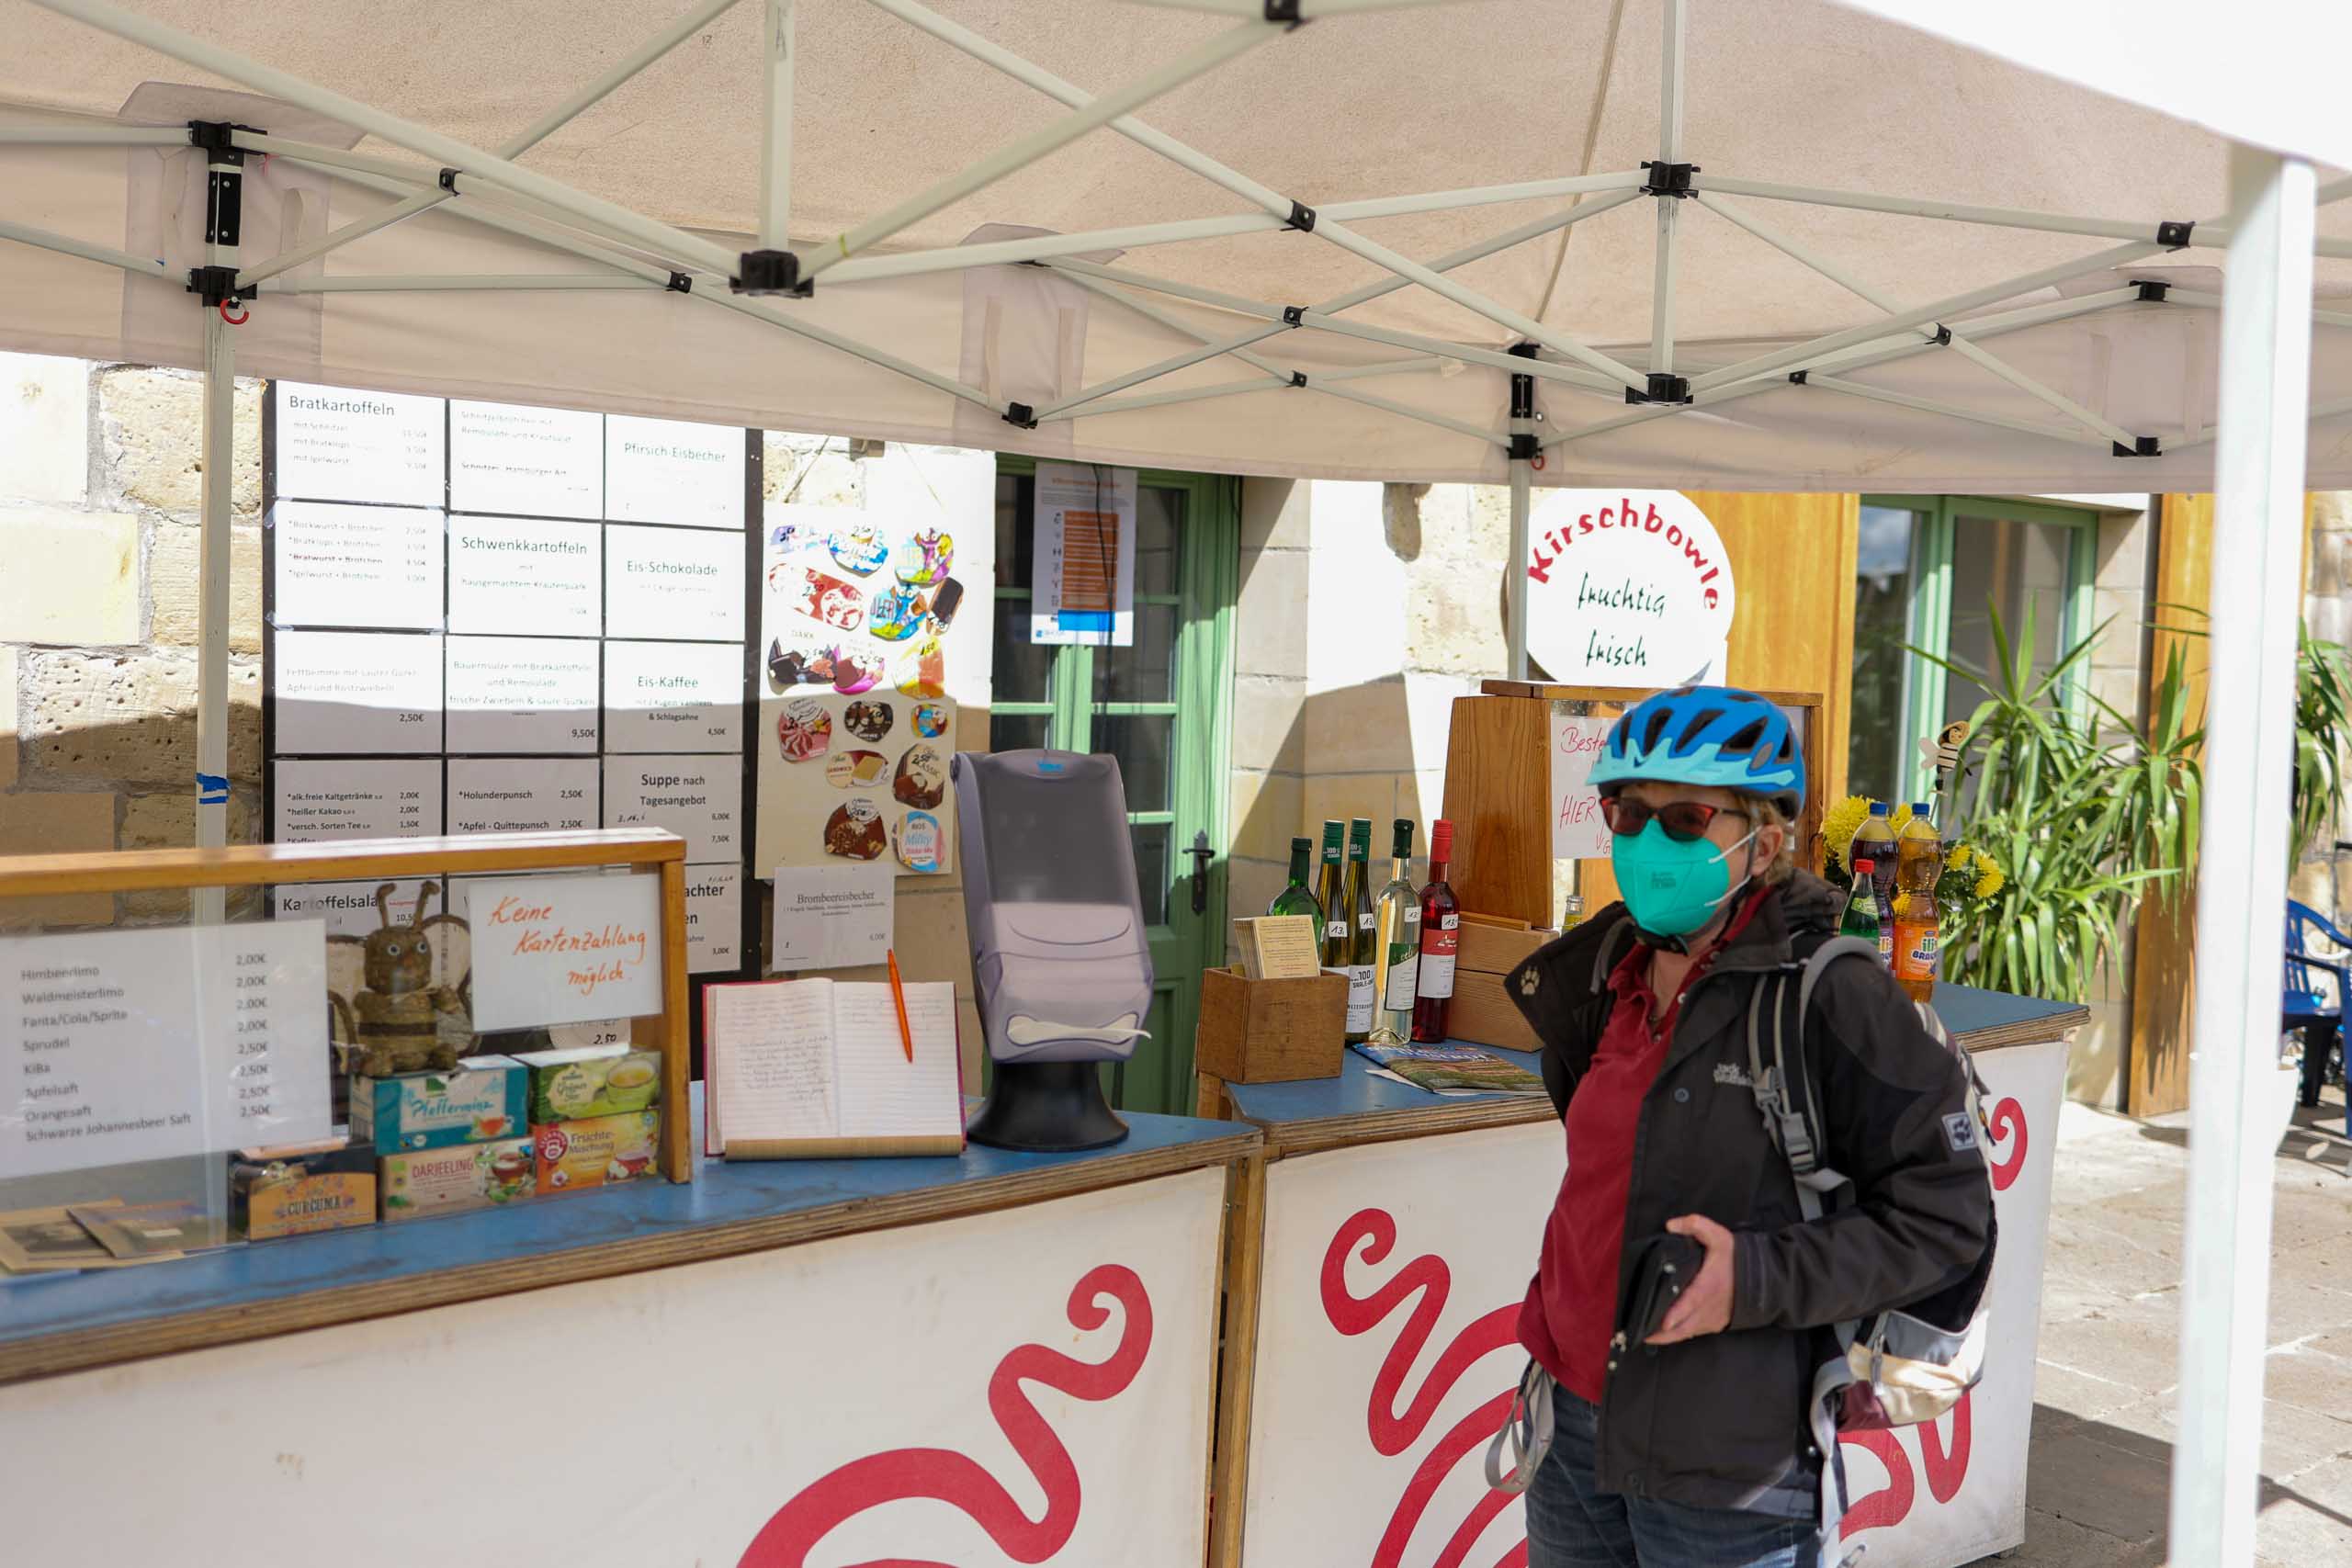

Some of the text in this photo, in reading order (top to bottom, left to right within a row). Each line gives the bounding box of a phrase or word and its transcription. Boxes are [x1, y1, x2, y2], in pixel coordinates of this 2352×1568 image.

[289, 395, 395, 416] Bratkartoffeln
[624, 442, 727, 464] Pfirsich-Eisbecher
[462, 536, 587, 554] Schwenkkartoffeln
[1527, 497, 1720, 612] Kirschbowle
[627, 558, 718, 576] Eis-Schokolade
[1577, 570, 1668, 617] fruchtig
[1585, 628, 1647, 668] frisch
[638, 676, 698, 688] Eis-Kaffee
[399, 713, 425, 723] 2,50€
[649, 713, 698, 723] & Schlagsahne
[571, 728, 596, 739] 9,50€
[707, 728, 726, 736] 4,50€
[641, 773, 706, 788] Suppe nach
[325, 793, 373, 803] Kaltgetränke
[400, 792, 420, 800] 2,00€
[560, 789, 583, 800] 2,50€
[639, 795, 707, 807] Tagesangebot
[319, 807, 343, 816] Kakao
[400, 806, 420, 815] 2,00€
[1559, 795, 1597, 829] HIER
[321, 822, 345, 830] Sorten
[347, 821, 361, 829] Tee
[400, 820, 420, 829] 1,50€
[493, 820, 549, 832] Quittepunsch
[560, 819, 583, 829] 2,50€
[711, 834, 730, 844] 7,50€
[283, 893, 381, 912] Kartoffelsala
[797, 890, 876, 905] Brombeereisbecher
[488, 896, 553, 927] Keine
[514, 924, 647, 965] Kartenzahlung
[712, 946, 730, 956] 3,00€
[20, 953, 266, 981] Himbeerlimo 2,00€
[21, 976, 267, 1005] Waldmeisterlimo 2,00€
[22, 998, 268, 1029] Fanta/Cola/Sprite 2,00€
[22, 1020, 268, 1054] Sprudel 2,00€
[23, 1042, 268, 1075] KiBa 2,50€
[25, 1064, 269, 1100] Apfelsaft 2,50€
[239, 1086, 271, 1100] 2,50€
[26, 1105, 272, 1143] Schwarze Johannesbeer Saft 2,50€
[411, 1157, 475, 1179] DARJEELING
[288, 1195, 341, 1215] CURCUMA
